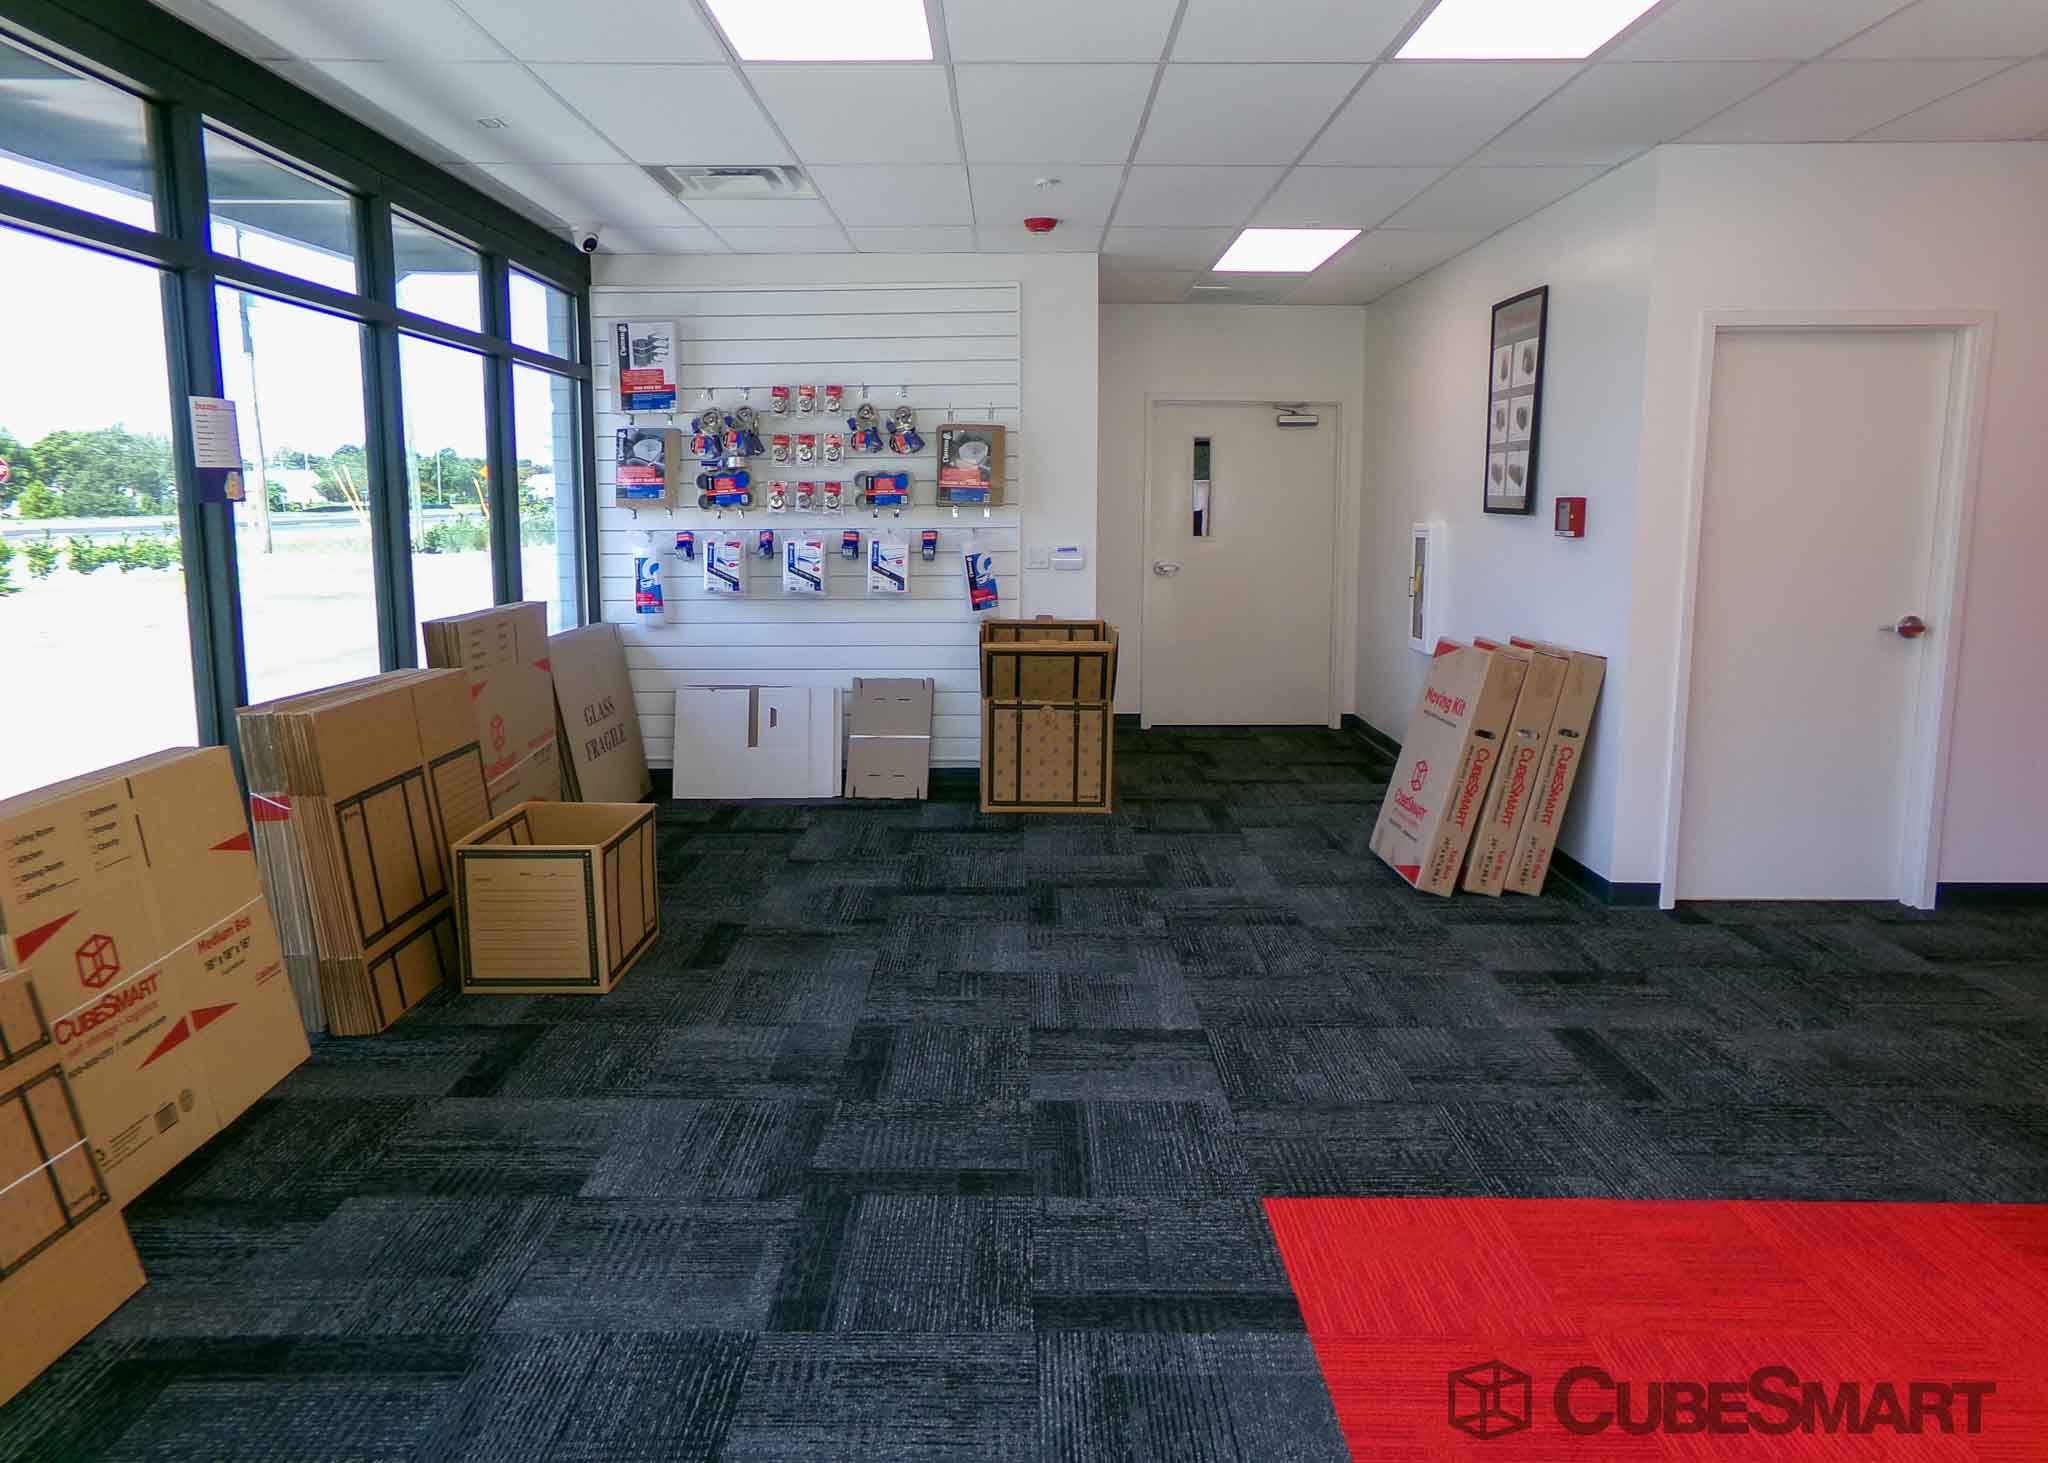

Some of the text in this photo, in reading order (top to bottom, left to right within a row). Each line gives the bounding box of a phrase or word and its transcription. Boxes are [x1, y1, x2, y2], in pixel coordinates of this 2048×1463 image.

[584, 695, 616, 727] GLASS
[1424, 687, 1467, 717] Moving Kit
[585, 722, 627, 763] FRAGILE
[197, 916, 252, 955] Medium Box
